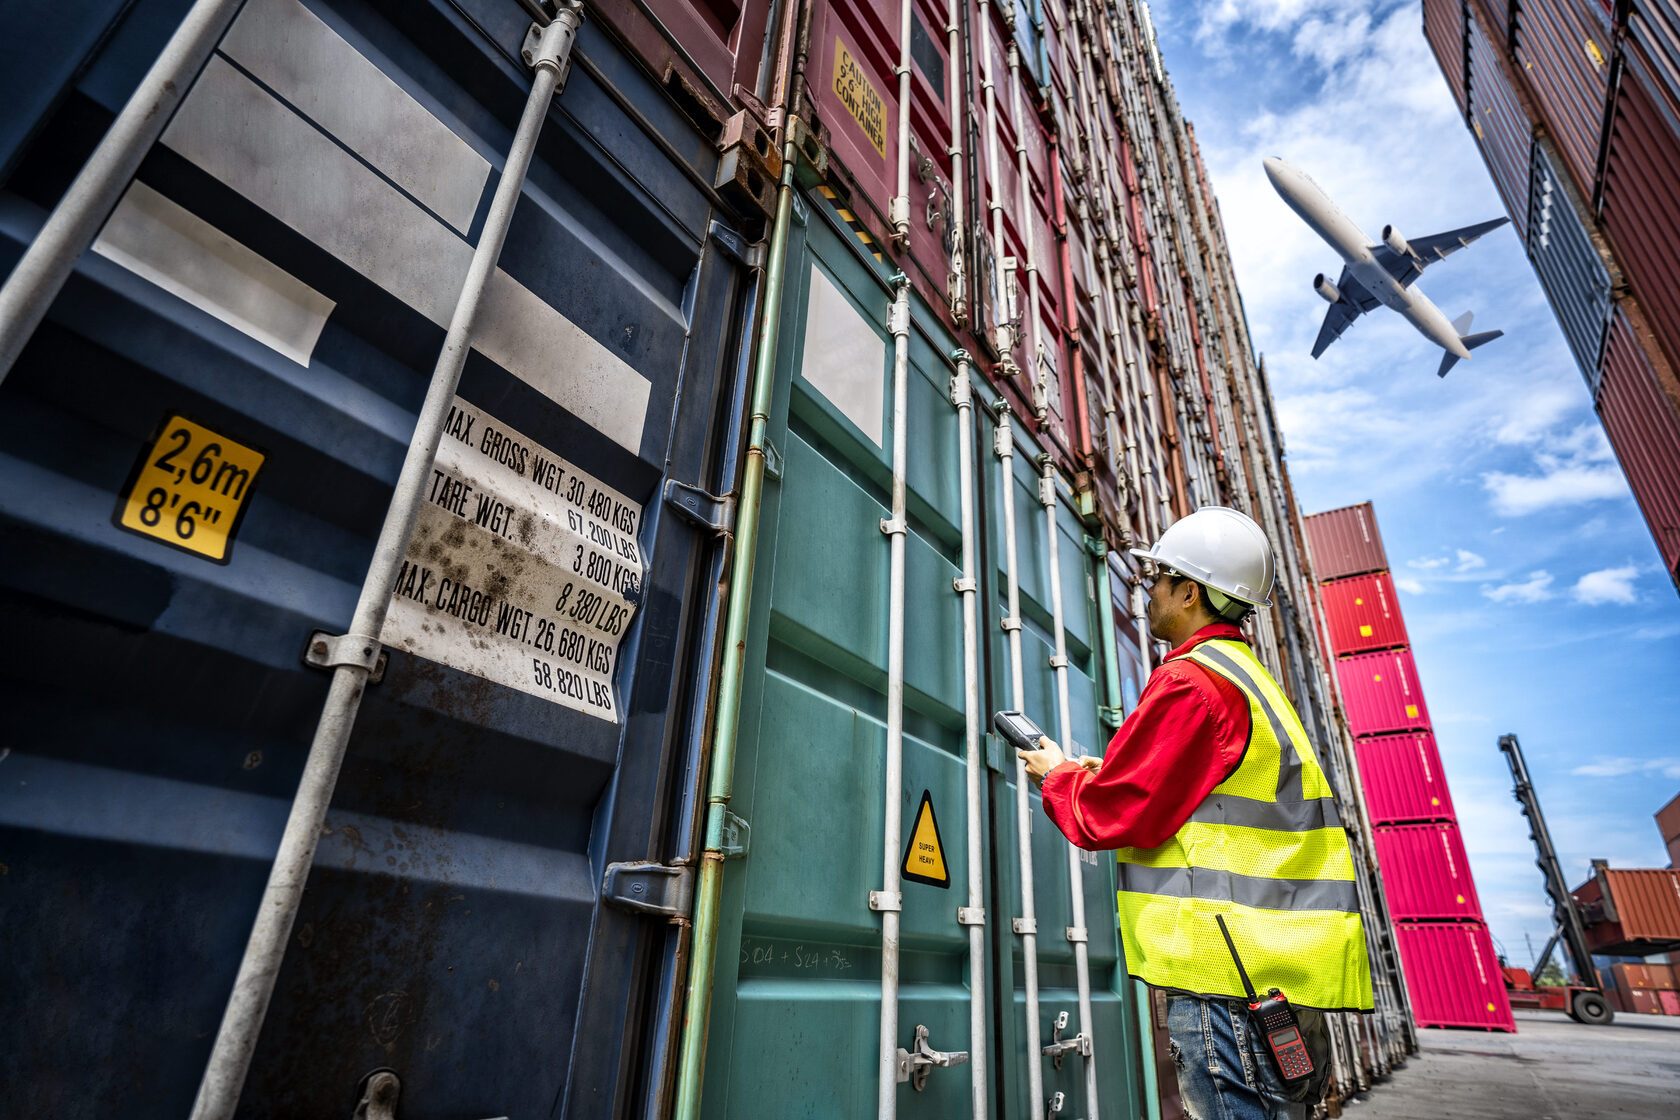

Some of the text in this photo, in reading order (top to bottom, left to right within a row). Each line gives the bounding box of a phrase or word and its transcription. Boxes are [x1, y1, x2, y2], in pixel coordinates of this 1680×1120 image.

[843, 51, 881, 114] CAUTION
[836, 78, 883, 152] CONTAINER
[862, 95, 882, 132] HIGH
[154, 428, 249, 500] 2,6m
[481, 427, 529, 475] GROSS
[533, 454, 565, 498] WGT.
[612, 501, 636, 535] KGS
[140, 487, 222, 540] 8'6"
[430, 469, 473, 518] TARE
[476, 493, 515, 540] WGT.
[613, 533, 638, 563] LBS
[436, 578, 492, 626] CARGO
[496, 601, 533, 645] WGT.
[585, 638, 612, 674] KGS
[595, 600, 628, 635] LBS
[585, 677, 611, 710] LBS
[918, 842, 935, 853] SUPER
[918, 855, 935, 866] HEAVY
